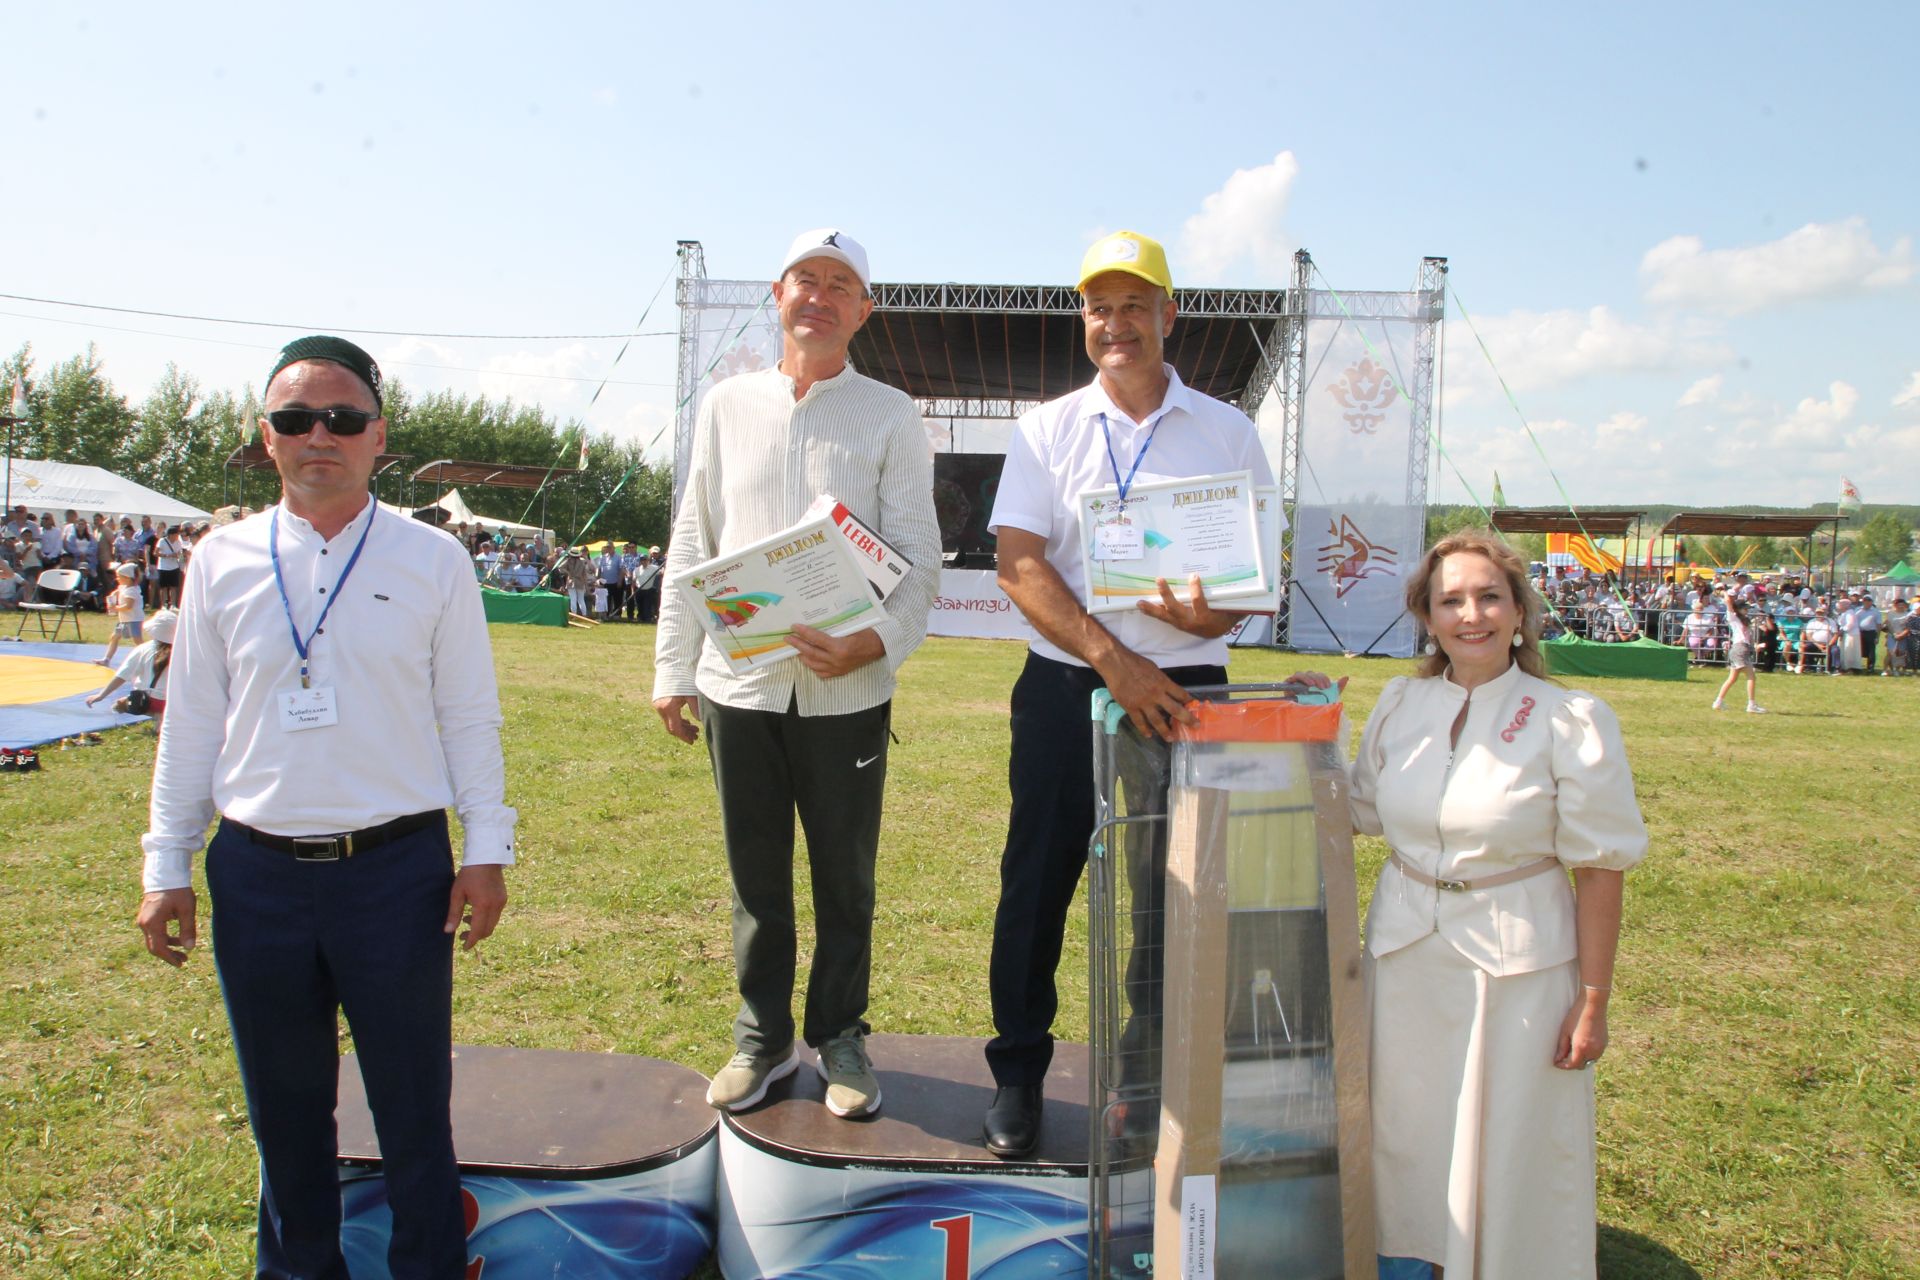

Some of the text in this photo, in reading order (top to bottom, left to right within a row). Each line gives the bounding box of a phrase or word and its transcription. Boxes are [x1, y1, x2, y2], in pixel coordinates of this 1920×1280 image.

[1172, 485, 1240, 509] ДИПЛОМ
[764, 530, 827, 568] ДИПЛОМ
[843, 523, 887, 562] LEBEN
[930, 1212, 973, 1280] 1
